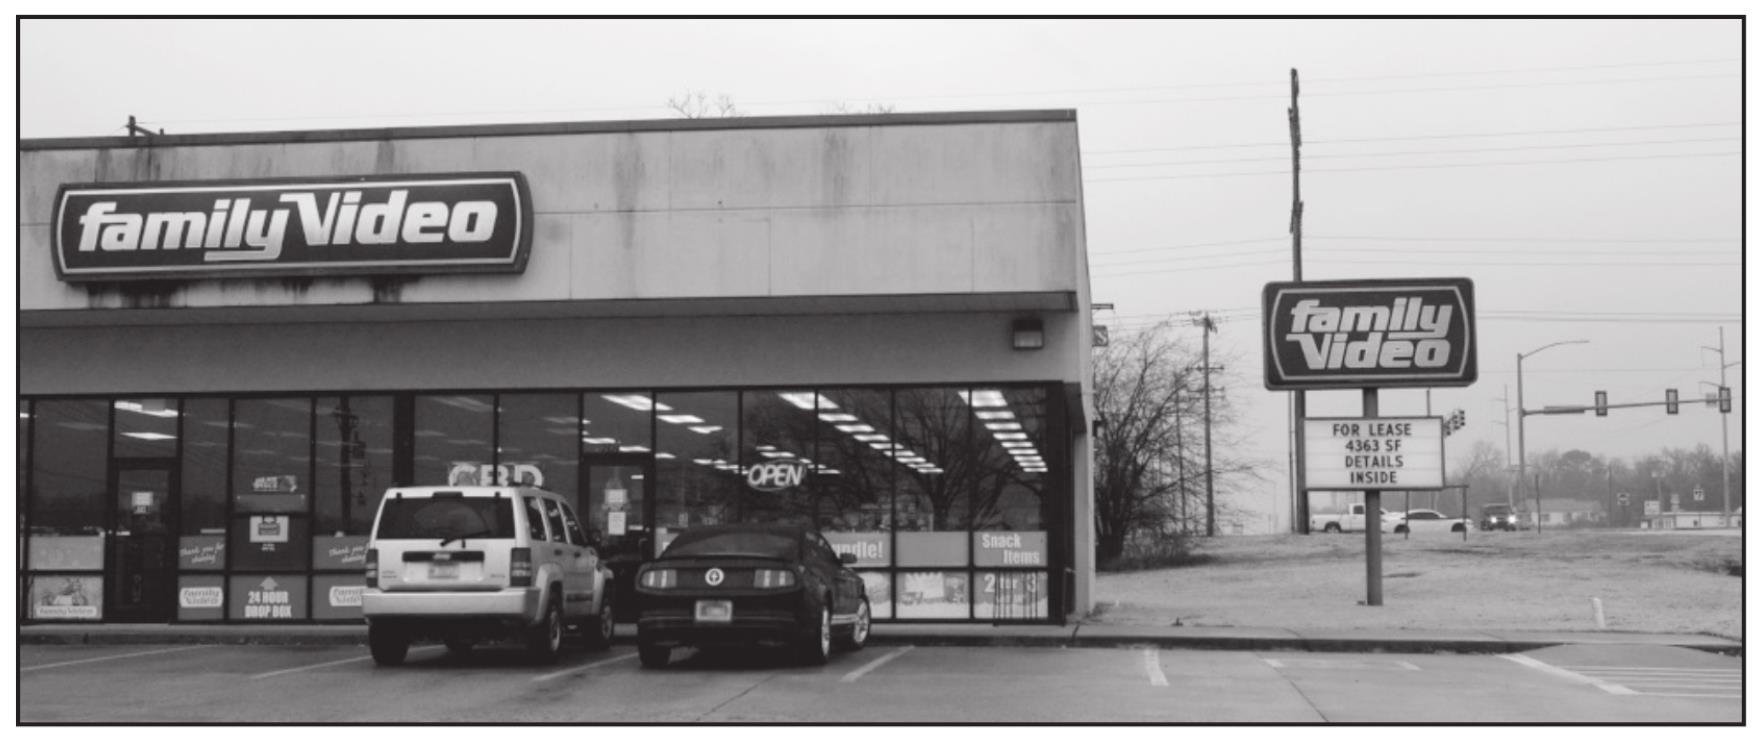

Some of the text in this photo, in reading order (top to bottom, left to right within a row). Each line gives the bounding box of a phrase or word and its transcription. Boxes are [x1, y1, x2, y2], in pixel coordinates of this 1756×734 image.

[78, 190, 498, 262] family Video
[1290, 297, 1453, 340] family
[1286, 332, 1452, 370] Video
[1333, 422, 1412, 437] FOR LEASE
[1345, 439, 1402, 452] 4363 SF
[1345, 455, 1404, 468] DETAILS
[448, 462, 543, 487] CBD
[747, 463, 804, 487] OPEN
[1350, 471, 1398, 484] INSIDE
[981, 533, 1021, 548] Snack
[1004, 549, 1040, 564] Items
[984, 573, 995, 593] 2
[248, 591, 289, 604] 24 HOUR
[244, 605, 292, 618] DROP BOX
